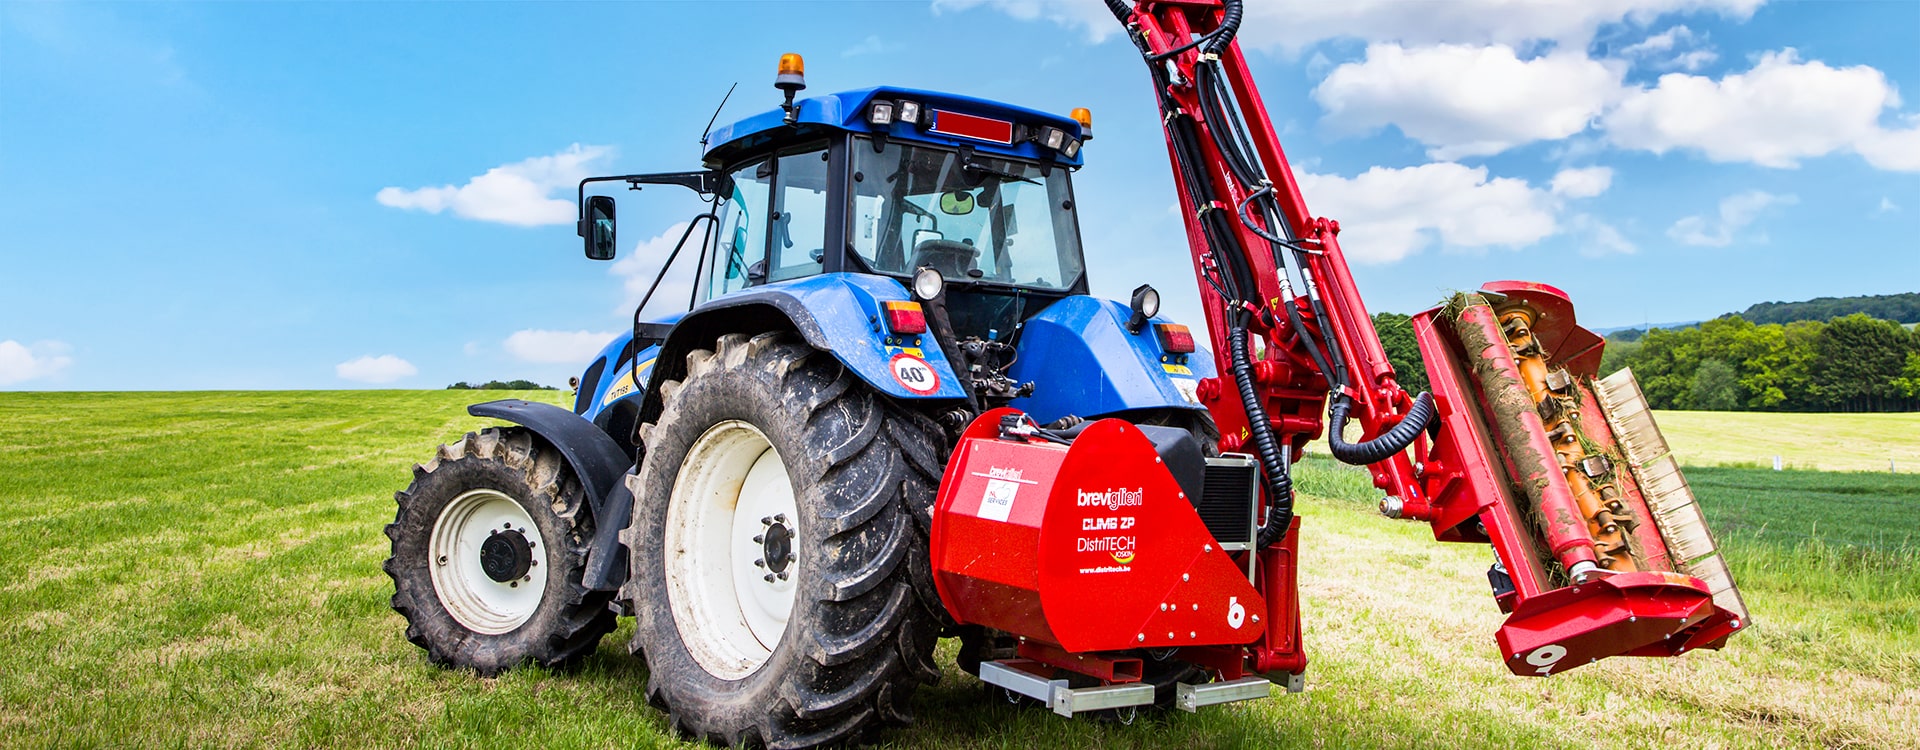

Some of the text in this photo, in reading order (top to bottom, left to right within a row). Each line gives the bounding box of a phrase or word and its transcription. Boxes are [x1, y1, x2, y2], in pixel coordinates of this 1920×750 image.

[901, 367, 925, 383] 40
[1077, 487, 1143, 511] breviglieri
[1082, 516, 1136, 531] CLIMB ZP
[1077, 536, 1136, 552] DistriTECH
